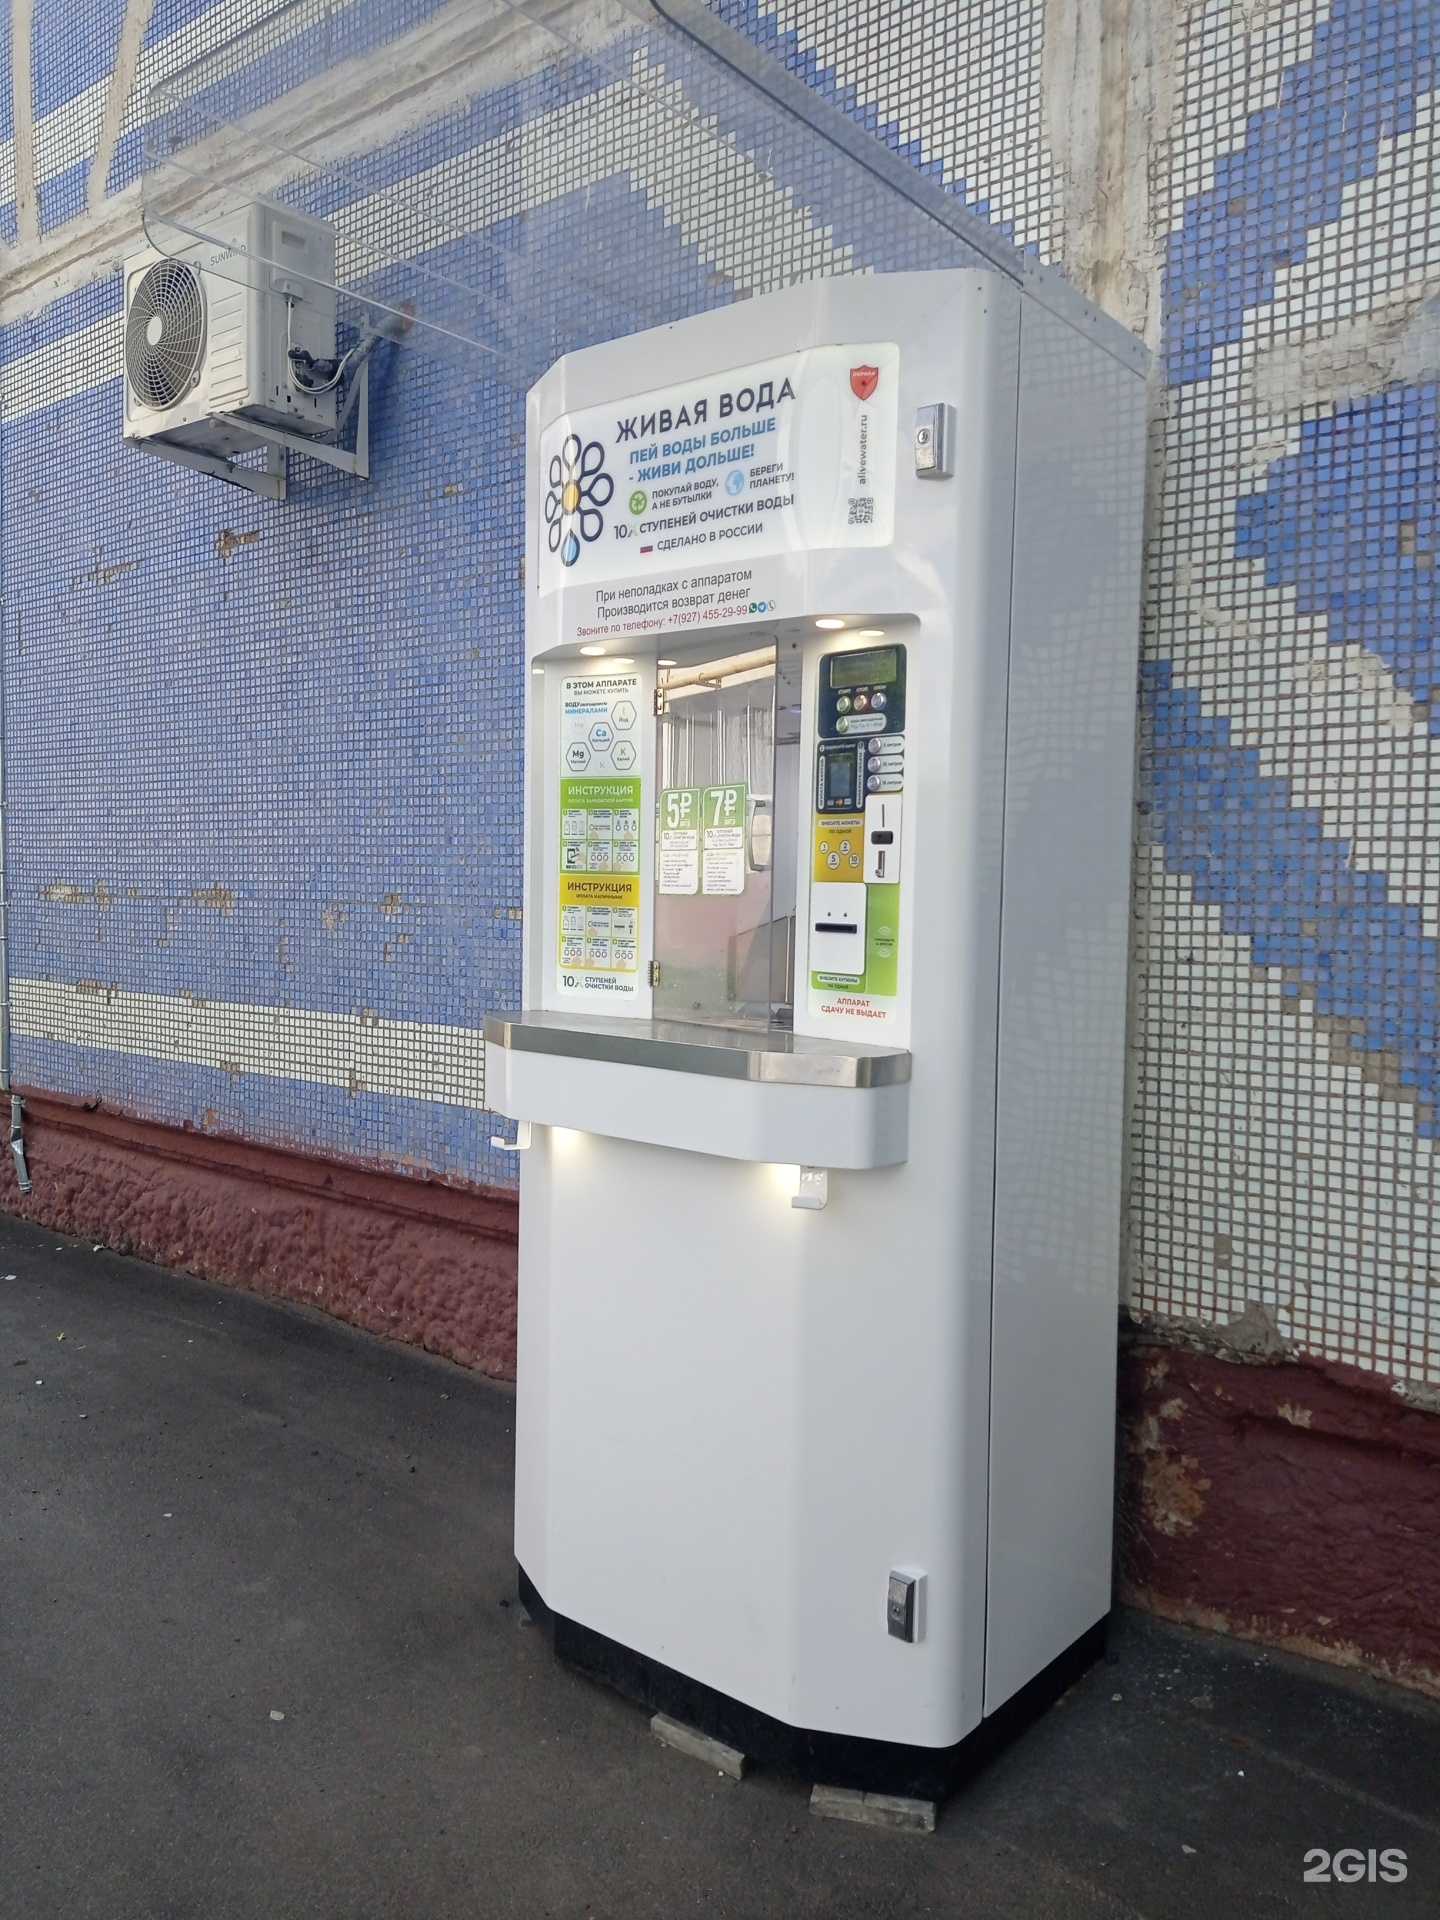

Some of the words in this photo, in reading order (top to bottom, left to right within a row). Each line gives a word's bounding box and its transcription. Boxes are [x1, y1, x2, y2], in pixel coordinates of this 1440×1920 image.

[615, 399, 708, 443] ЖИВАЯ
[719, 377, 796, 418] ВОДА
[630, 444, 658, 465] ПЕЙ
[662, 435, 706, 457] ВОДЫ
[711, 417, 776, 445] БОЛЬШЕ
[858, 415, 868, 485] alivewater.ru
[638, 463, 681, 482] ЖИВИ
[685, 444, 755, 474] ДОЛЬШЕ!
[750, 463, 783, 477] БЕРЕГИ
[652, 482, 692, 499] ПОКУПАЙ
[694, 478, 719, 492] ВОДУ,
[750, 472, 795, 489] ПЛАНЕТУ!
[652, 502, 658, 510] А
[659, 500, 671, 509] НЕ
[672, 491, 712, 507] БУТЫЛКИ
[639, 512, 697, 534] СТУПЕНЕЙ
[700, 502, 754, 522] ОЧИСТКИ
[757, 494, 795, 512] ВОДЫ
[657, 533, 706, 551] СДЕЛАНО
[709, 531, 717, 542] В
[719, 523, 763, 541] РОССИИ
[596, 590, 616, 606] При
[618, 583, 679, 600] неполадках
[682, 579, 688, 589] с
[691, 569, 752, 589] аппаратом
[597, 602, 669, 621] Производится
[672, 592, 714, 609] возврат
[718, 588, 751, 604] денег
[577, 626, 609, 637] Звоните
[610, 625, 621, 633] по
[623, 617, 665, 632] телефону:
[668, 611, 701, 626] +7(927)
[703, 606, 748, 620] 455-29-99
[573, 681, 594, 689] ЭТОМ
[596, 679, 637, 688] АППАРАТЕ
[595, 729, 607, 737] Ca
[572, 750, 585, 759] Mg
[568, 785, 633, 796] ИНСТРУКЦИЯ
[567, 881, 632, 893] ИНСТРУКЦИЯ
[585, 976, 617, 984] СТУПЕНЕЙ
[585, 983, 614, 991] ОЧИСТКИ
[615, 984, 634, 992] ВОДЫ
[837, 997, 870, 1007] АППАРАТ
[821, 1005, 845, 1014] СДАЧУ
[845, 1007, 855, 1015] НЕ
[856, 1008, 887, 1019] ВЫДАЕТ
